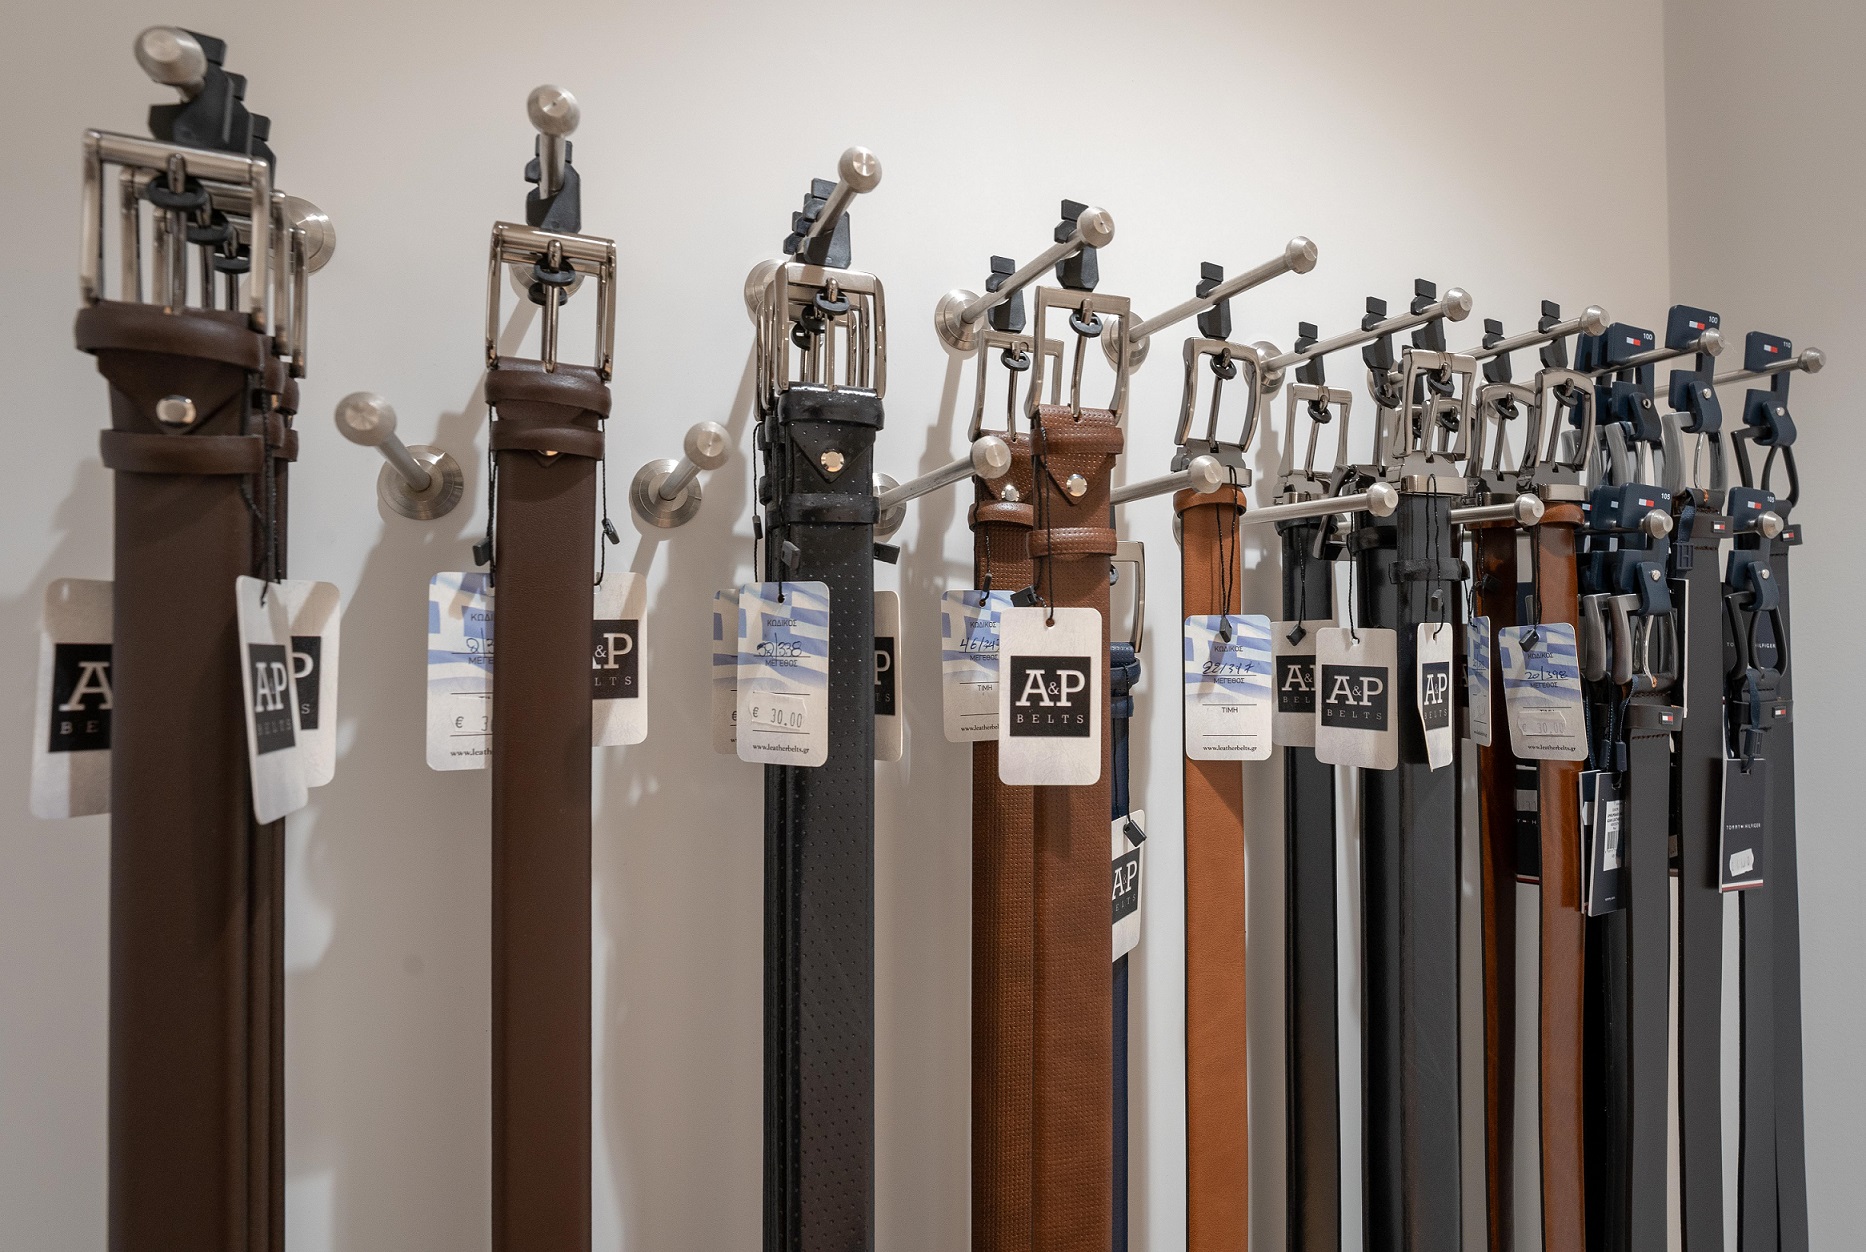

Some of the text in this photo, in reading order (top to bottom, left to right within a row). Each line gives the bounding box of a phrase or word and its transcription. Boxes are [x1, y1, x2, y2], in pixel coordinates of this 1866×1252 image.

[1708, 315, 1719, 324] 100
[1642, 332, 1653, 341] 100
[1661, 492, 1671, 500] 105
[767, 619, 797, 627] ΚΩΔΙΚΟΣ
[1015, 669, 1086, 707] A&P
[1325, 675, 1384, 706] A&P
[1423, 672, 1448, 706] A&P
[752, 706, 803, 729] € 30.00
[1016, 713, 1084, 724] BELTS
[1326, 708, 1382, 721] BELTS
[455, 715, 492, 732] € 3
[752, 743, 810, 755] www.leatherbelts.gr
[1202, 744, 1258, 752] www.leatherbelts.gr
